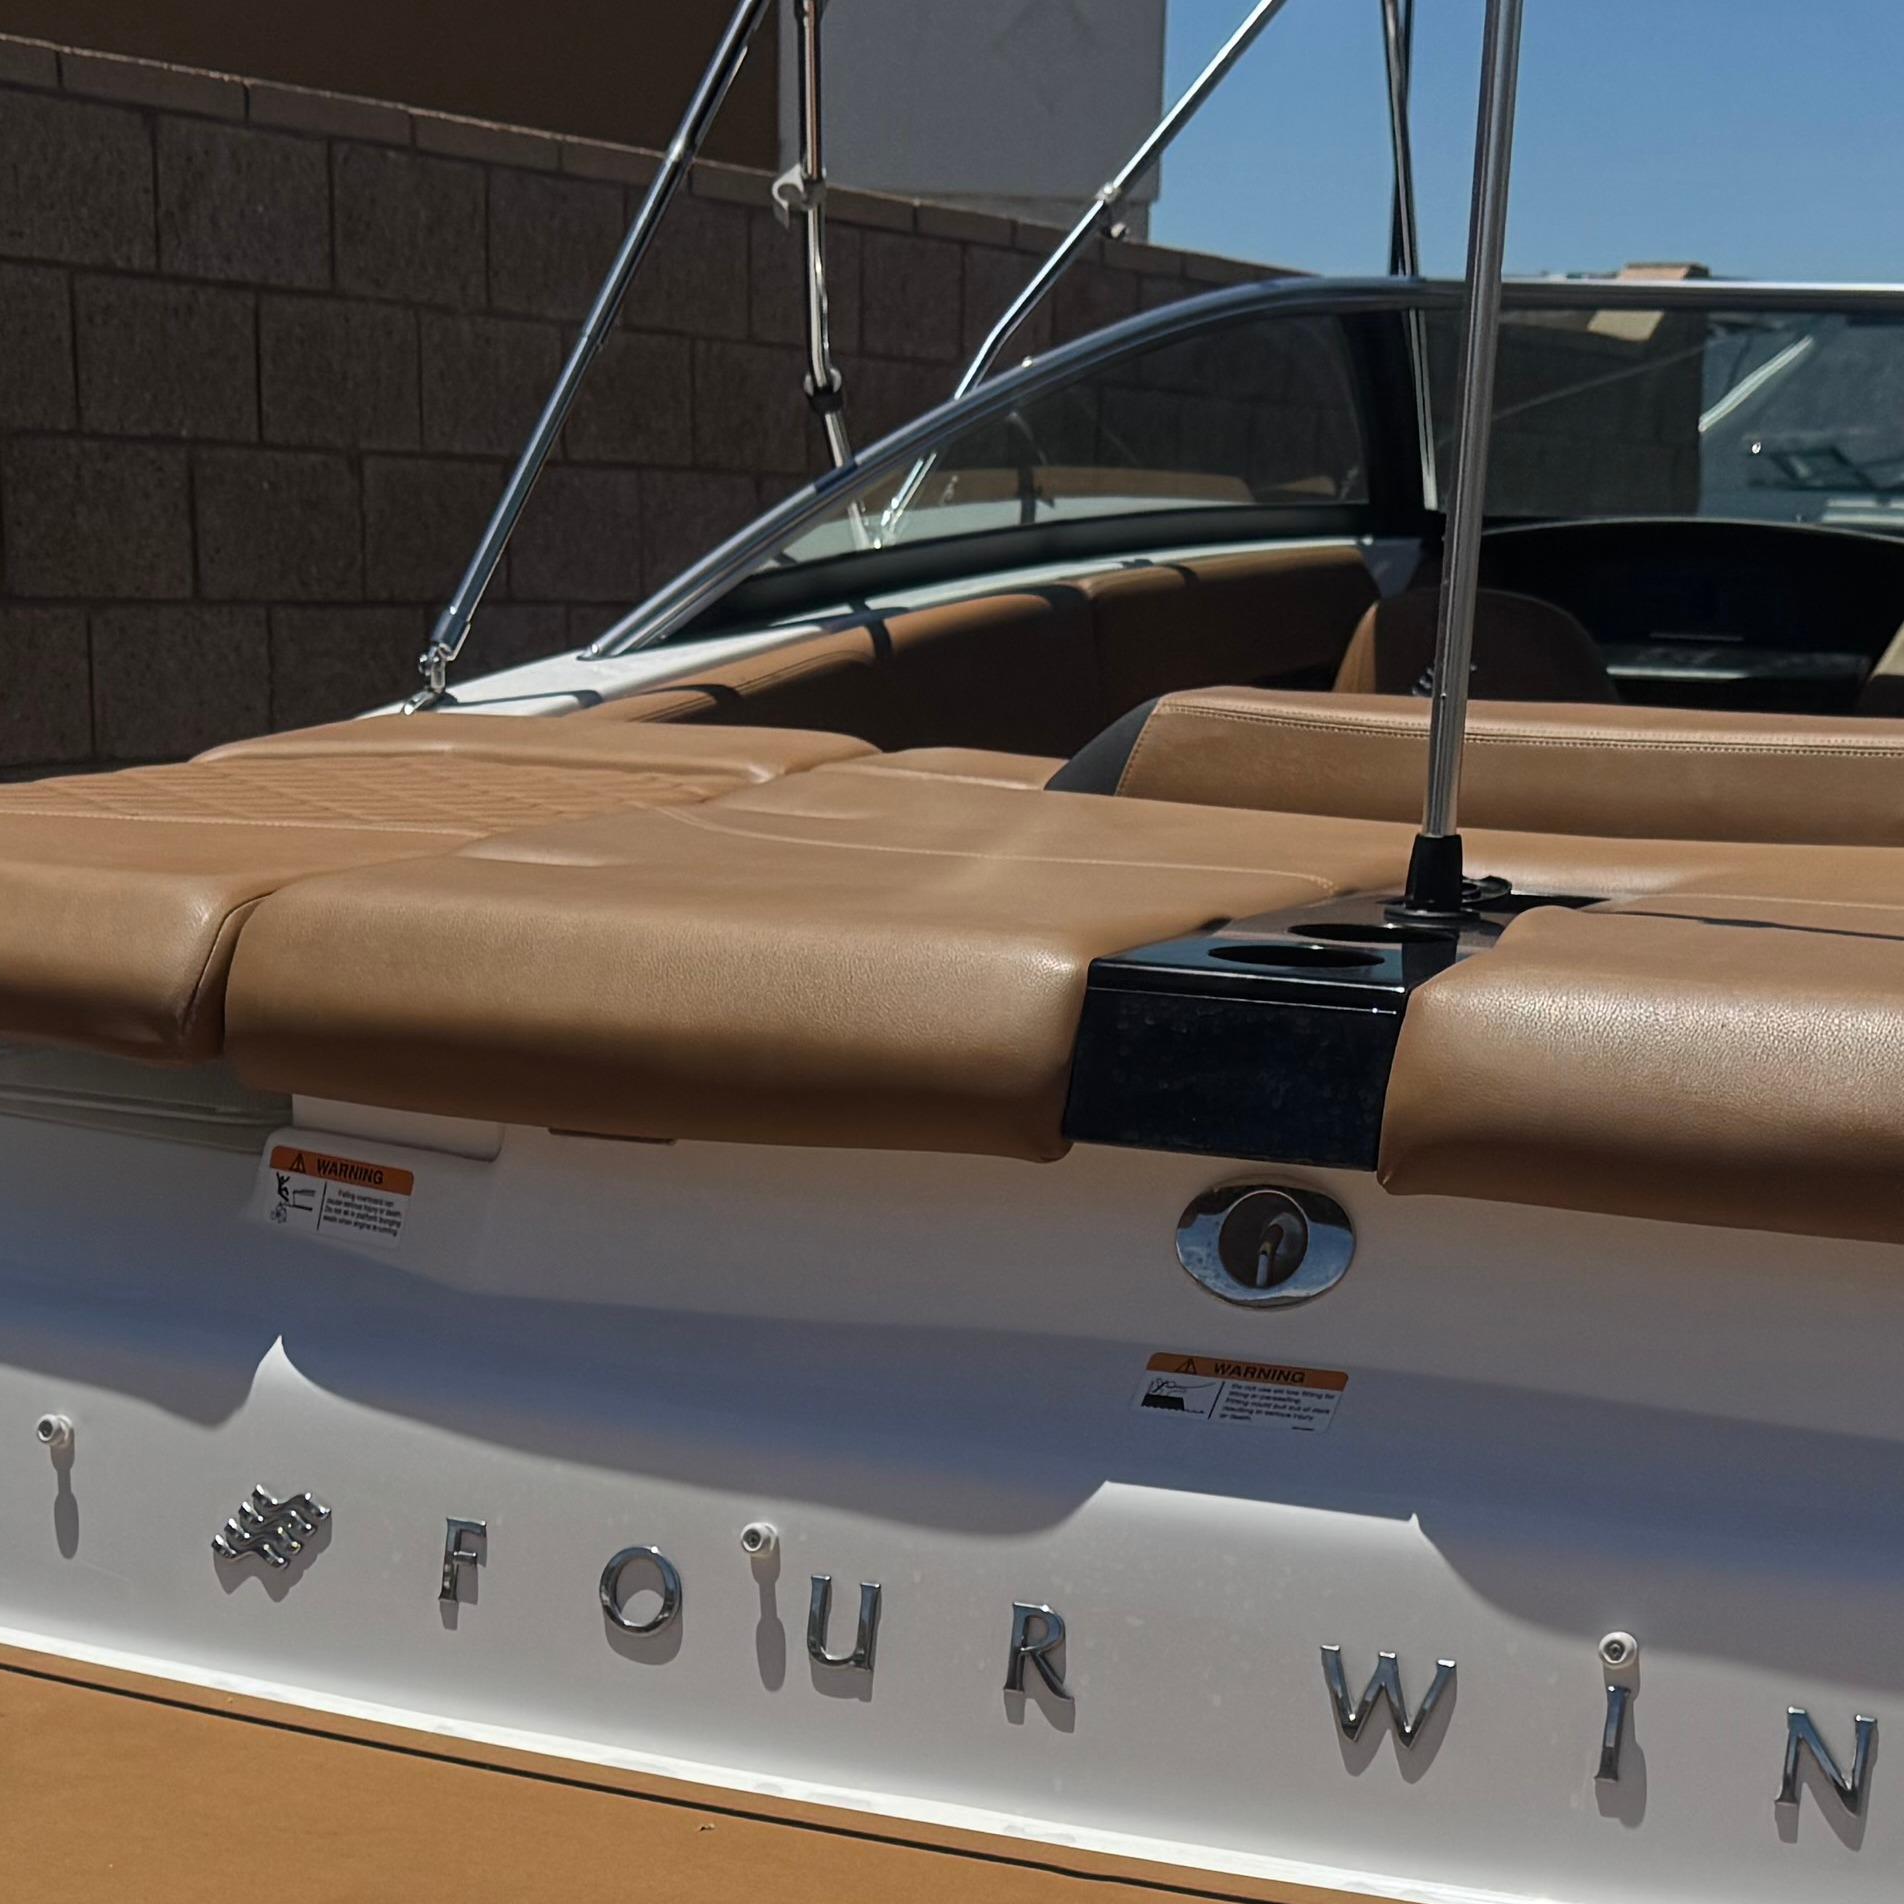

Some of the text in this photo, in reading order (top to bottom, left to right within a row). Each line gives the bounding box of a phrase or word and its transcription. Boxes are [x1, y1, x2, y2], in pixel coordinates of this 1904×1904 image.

[316, 1158, 384, 1186] WARNING
[1213, 1362, 1306, 1384] WARNING
[439, 1516, 1076, 1702] FOUR
